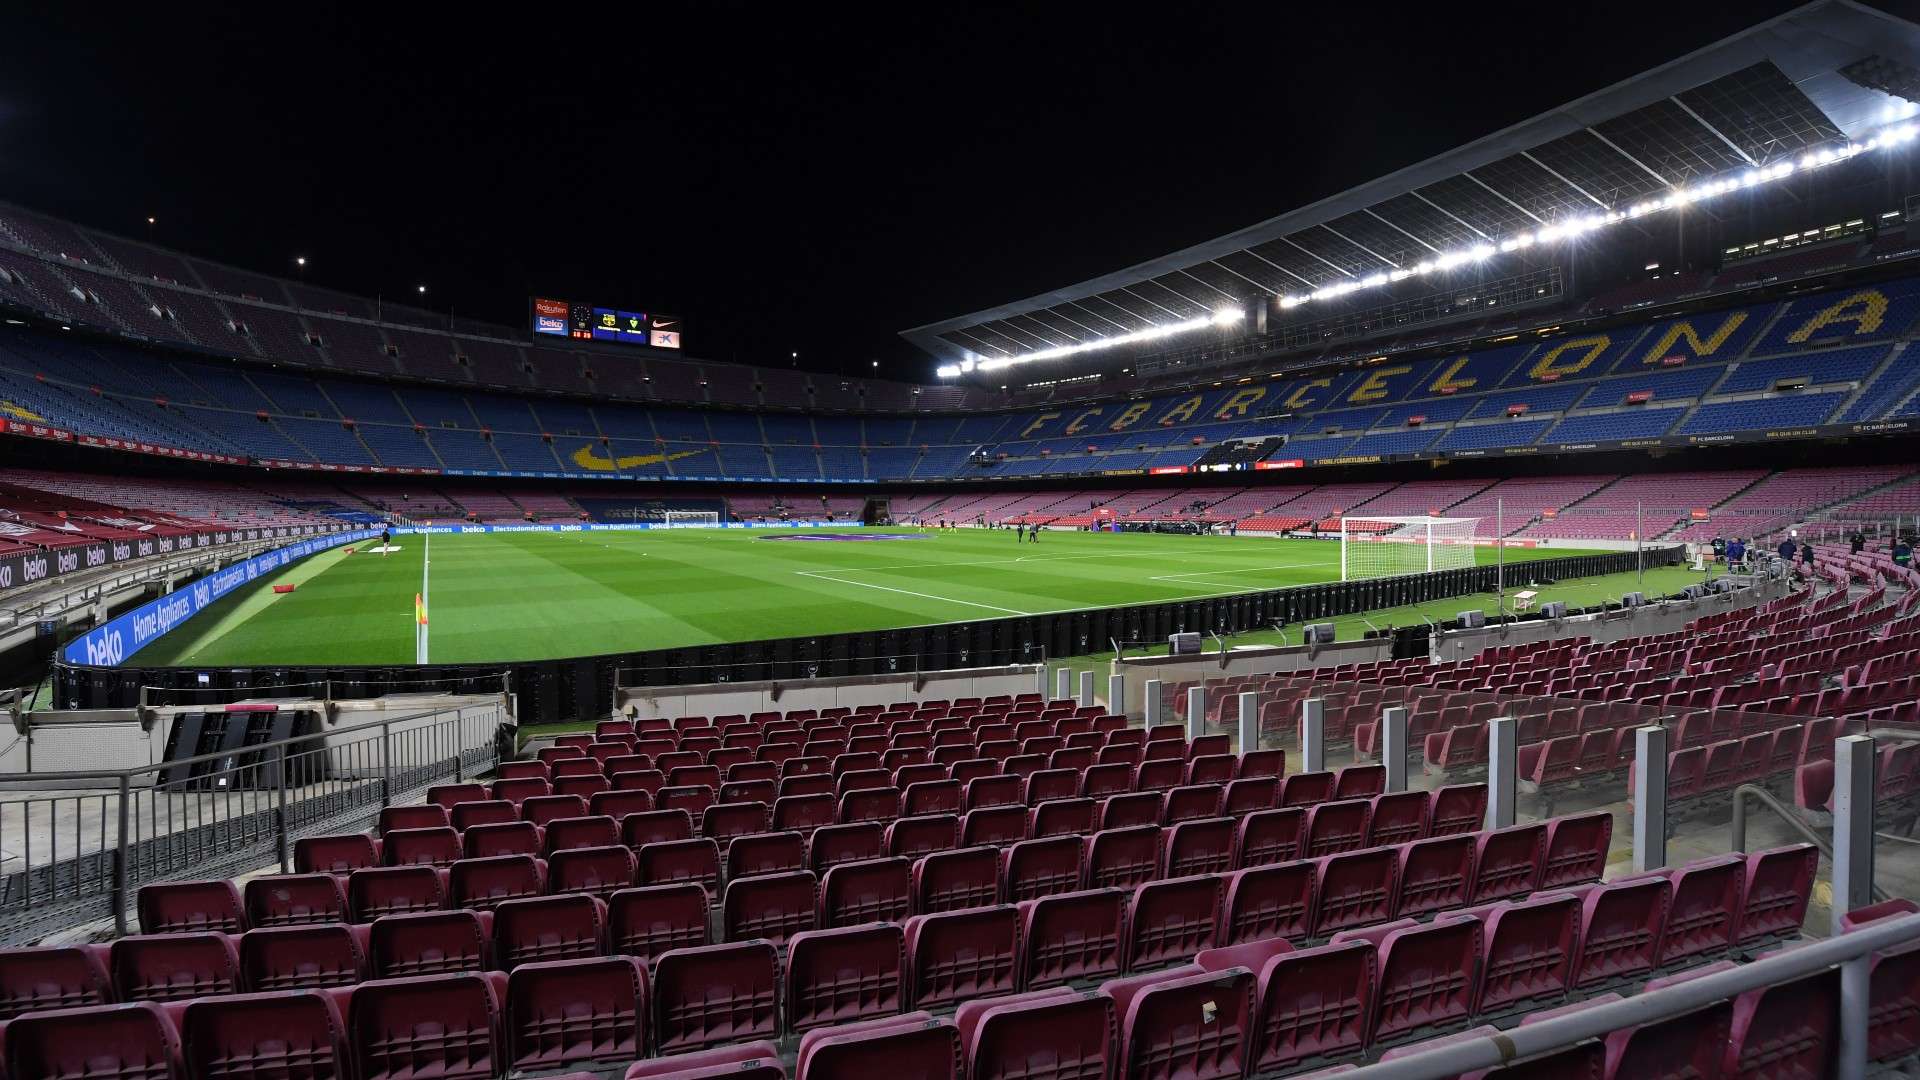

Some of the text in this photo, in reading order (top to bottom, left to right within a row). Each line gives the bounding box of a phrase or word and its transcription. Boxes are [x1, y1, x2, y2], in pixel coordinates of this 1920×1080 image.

[537, 303, 567, 314] Rakuten
[540, 317, 563, 328] beko
[1871, 422, 1908, 430] BARELONA
[370, 521, 388, 530] beko
[462, 525, 486, 533] beko
[610, 523, 641, 531] Appliances
[138, 538, 153, 557] beko
[159, 536, 173, 552] beko
[179, 534, 192, 549] beko
[197, 532, 210, 547] beko
[86, 545, 105, 566] beko
[113, 541, 131, 560] beko
[23, 555, 47, 582] beko
[58, 549, 78, 573] beko
[247, 559, 258, 581] beko
[194, 580, 210, 610] beko
[133, 595, 190, 644] Home Appliances
[86, 627, 123, 666] beko
